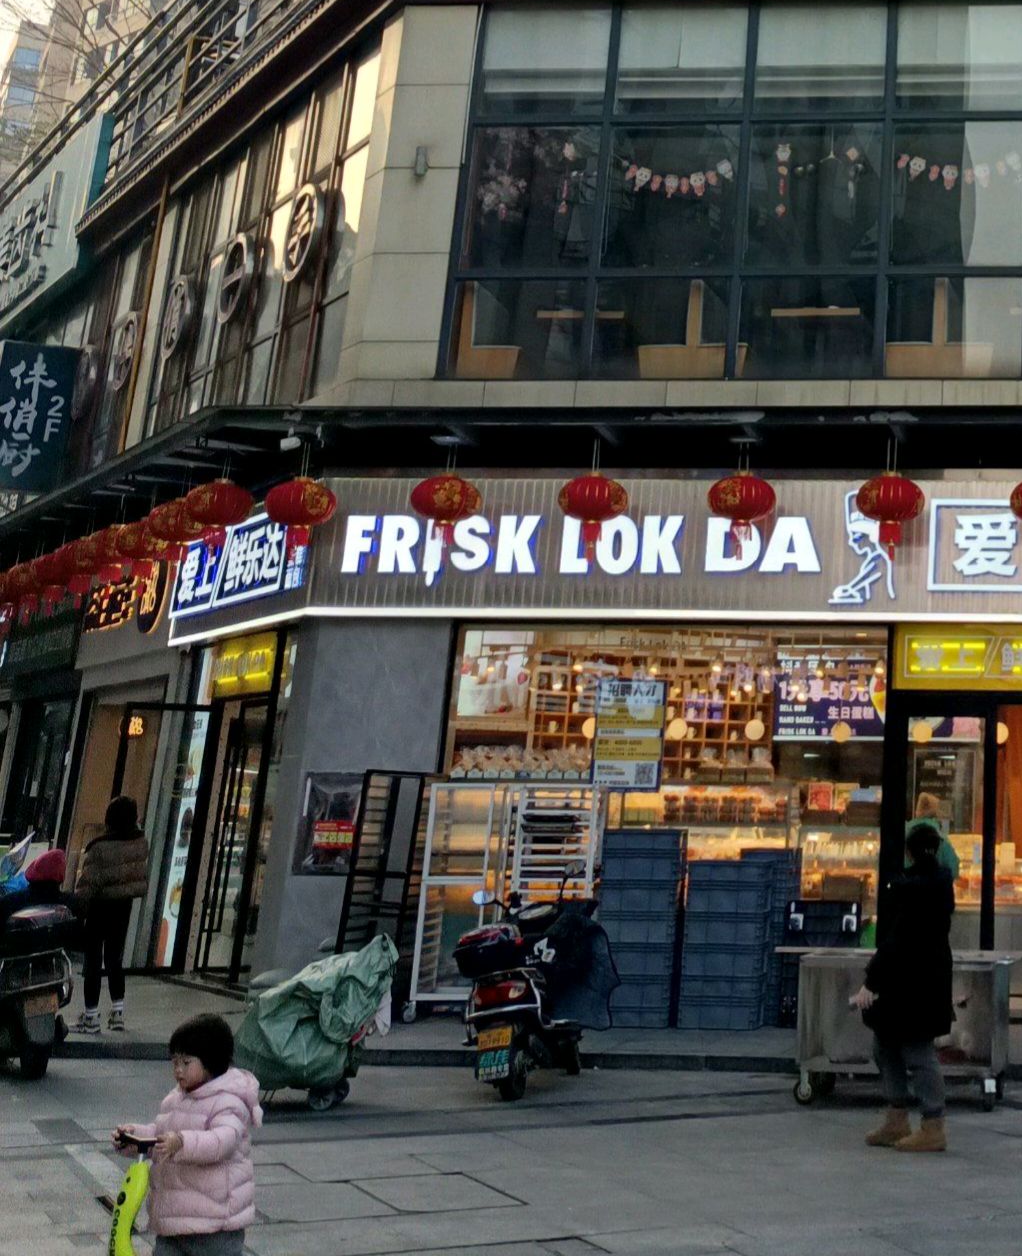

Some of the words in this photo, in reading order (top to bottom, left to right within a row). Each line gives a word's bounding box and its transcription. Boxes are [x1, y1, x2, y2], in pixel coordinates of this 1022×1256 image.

[43, 395, 65, 442] 2F
[177, 549, 217, 602] 爱上
[223, 523, 284, 591] 鲜乐达
[341, 515, 543, 586] FRISK
[559, 515, 684, 574] LOK
[704, 517, 821, 572] DA
